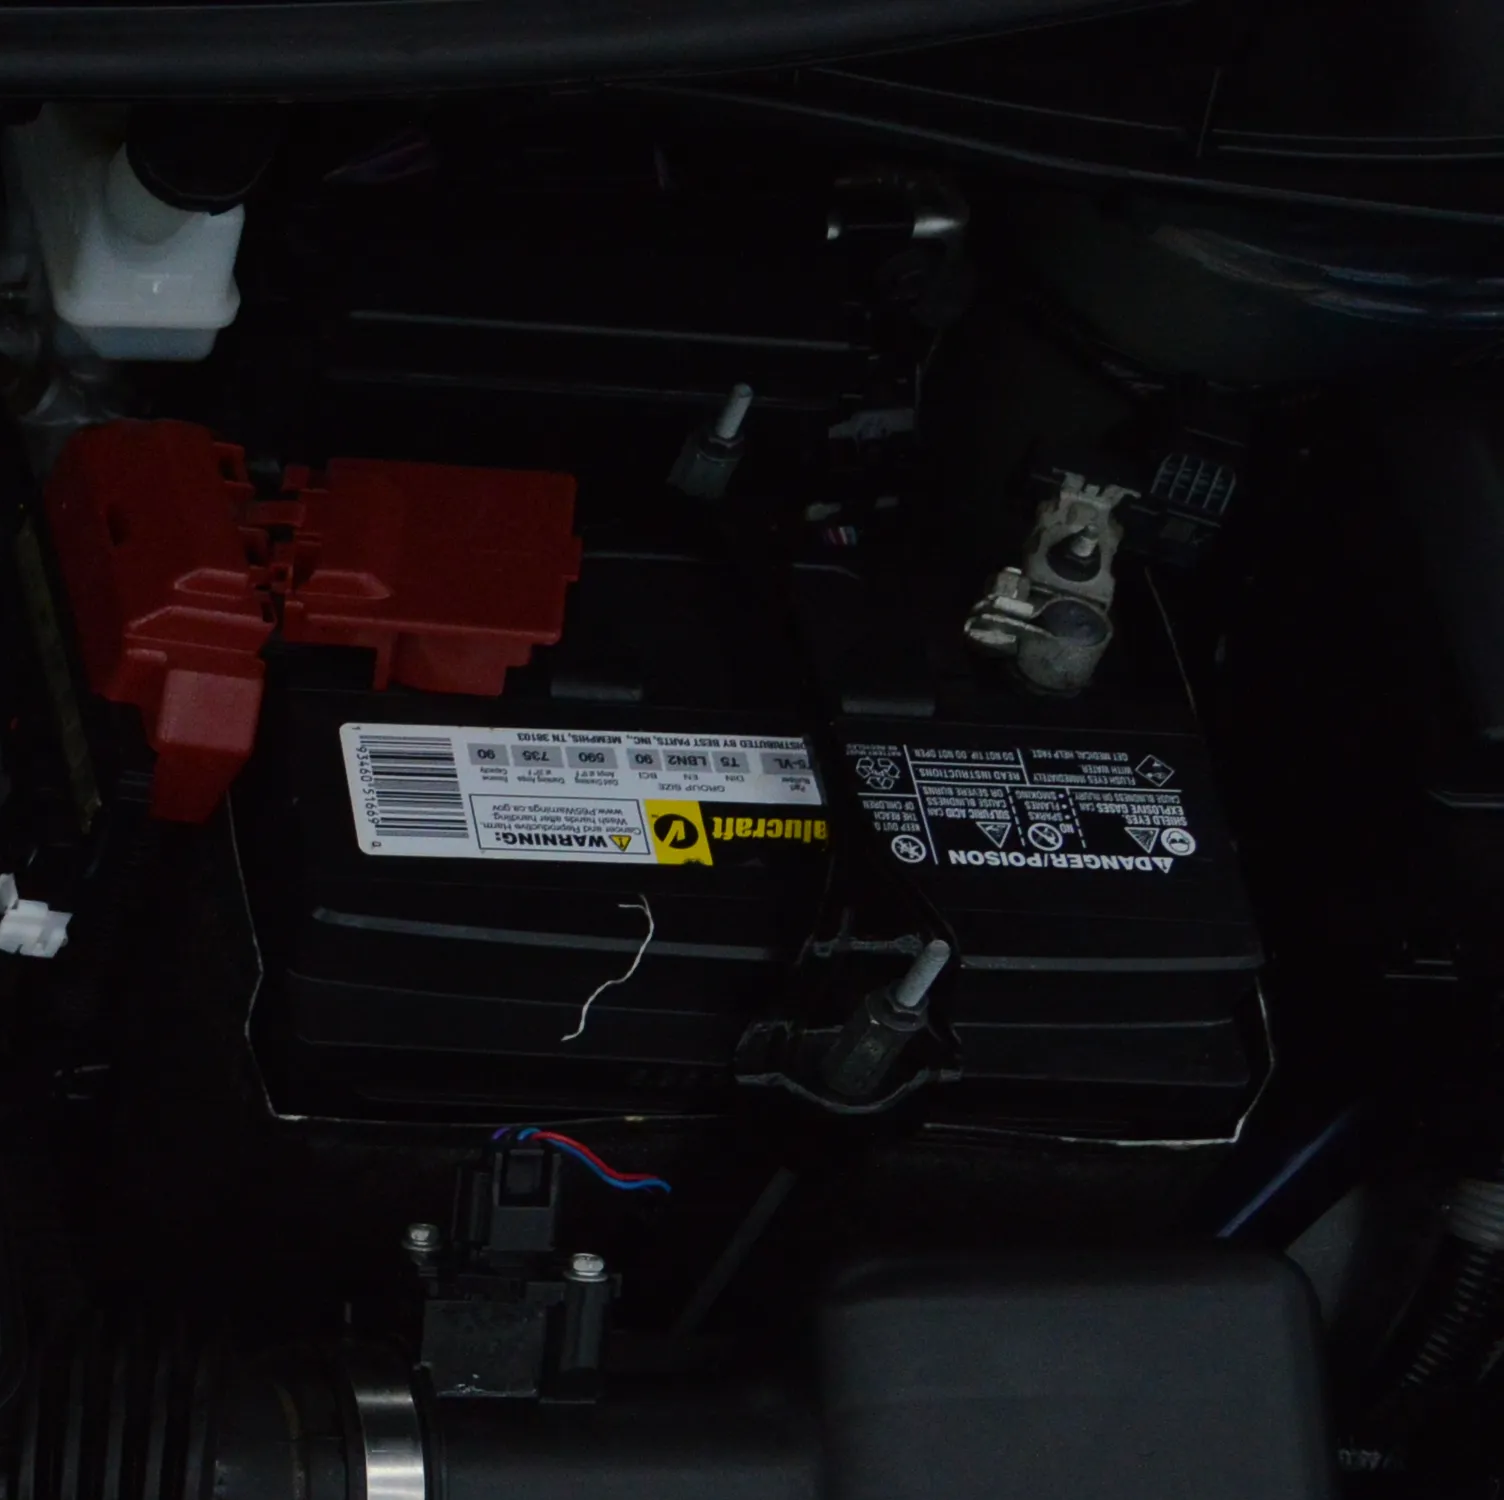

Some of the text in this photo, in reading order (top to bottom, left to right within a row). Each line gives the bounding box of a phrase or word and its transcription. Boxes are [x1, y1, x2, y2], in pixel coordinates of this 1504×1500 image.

[517, 733, 549, 742] 38103
[552, 733, 566, 742] TN
[693, 738, 719, 747] BEST
[723, 740, 737, 748] BY
[477, 749, 495, 760] 90
[523, 750, 549, 761] 735
[579, 752, 605, 763] 590
[635, 754, 653, 764] 90
[668, 755, 707, 766] LBN2
[720, 757, 740, 767] T5
[639, 772, 658, 780] BCI
[993, 771, 1021, 780] READ
[659, 783, 726, 793] GROUP SIZE
[956, 787, 989, 797] SEVERE
[926, 797, 1006, 808] CAUSE BLINDNESS
[945, 808, 967, 818] ACID
[1096, 803, 1129, 813] GASES
[1129, 804, 1184, 815] EXPLOSIVE
[967, 809, 1011, 820] SULFURIC
[599, 817, 627, 826] Wash
[1152, 815, 1188, 826] SHIELD
[515, 822, 580, 833] Reproductive
[606, 827, 642, 836] Cancer
[712, 816, 829, 845] alucraft
[495, 832, 608, 847] WARNING:
[948, 850, 1152, 871] DANGER/POISON
